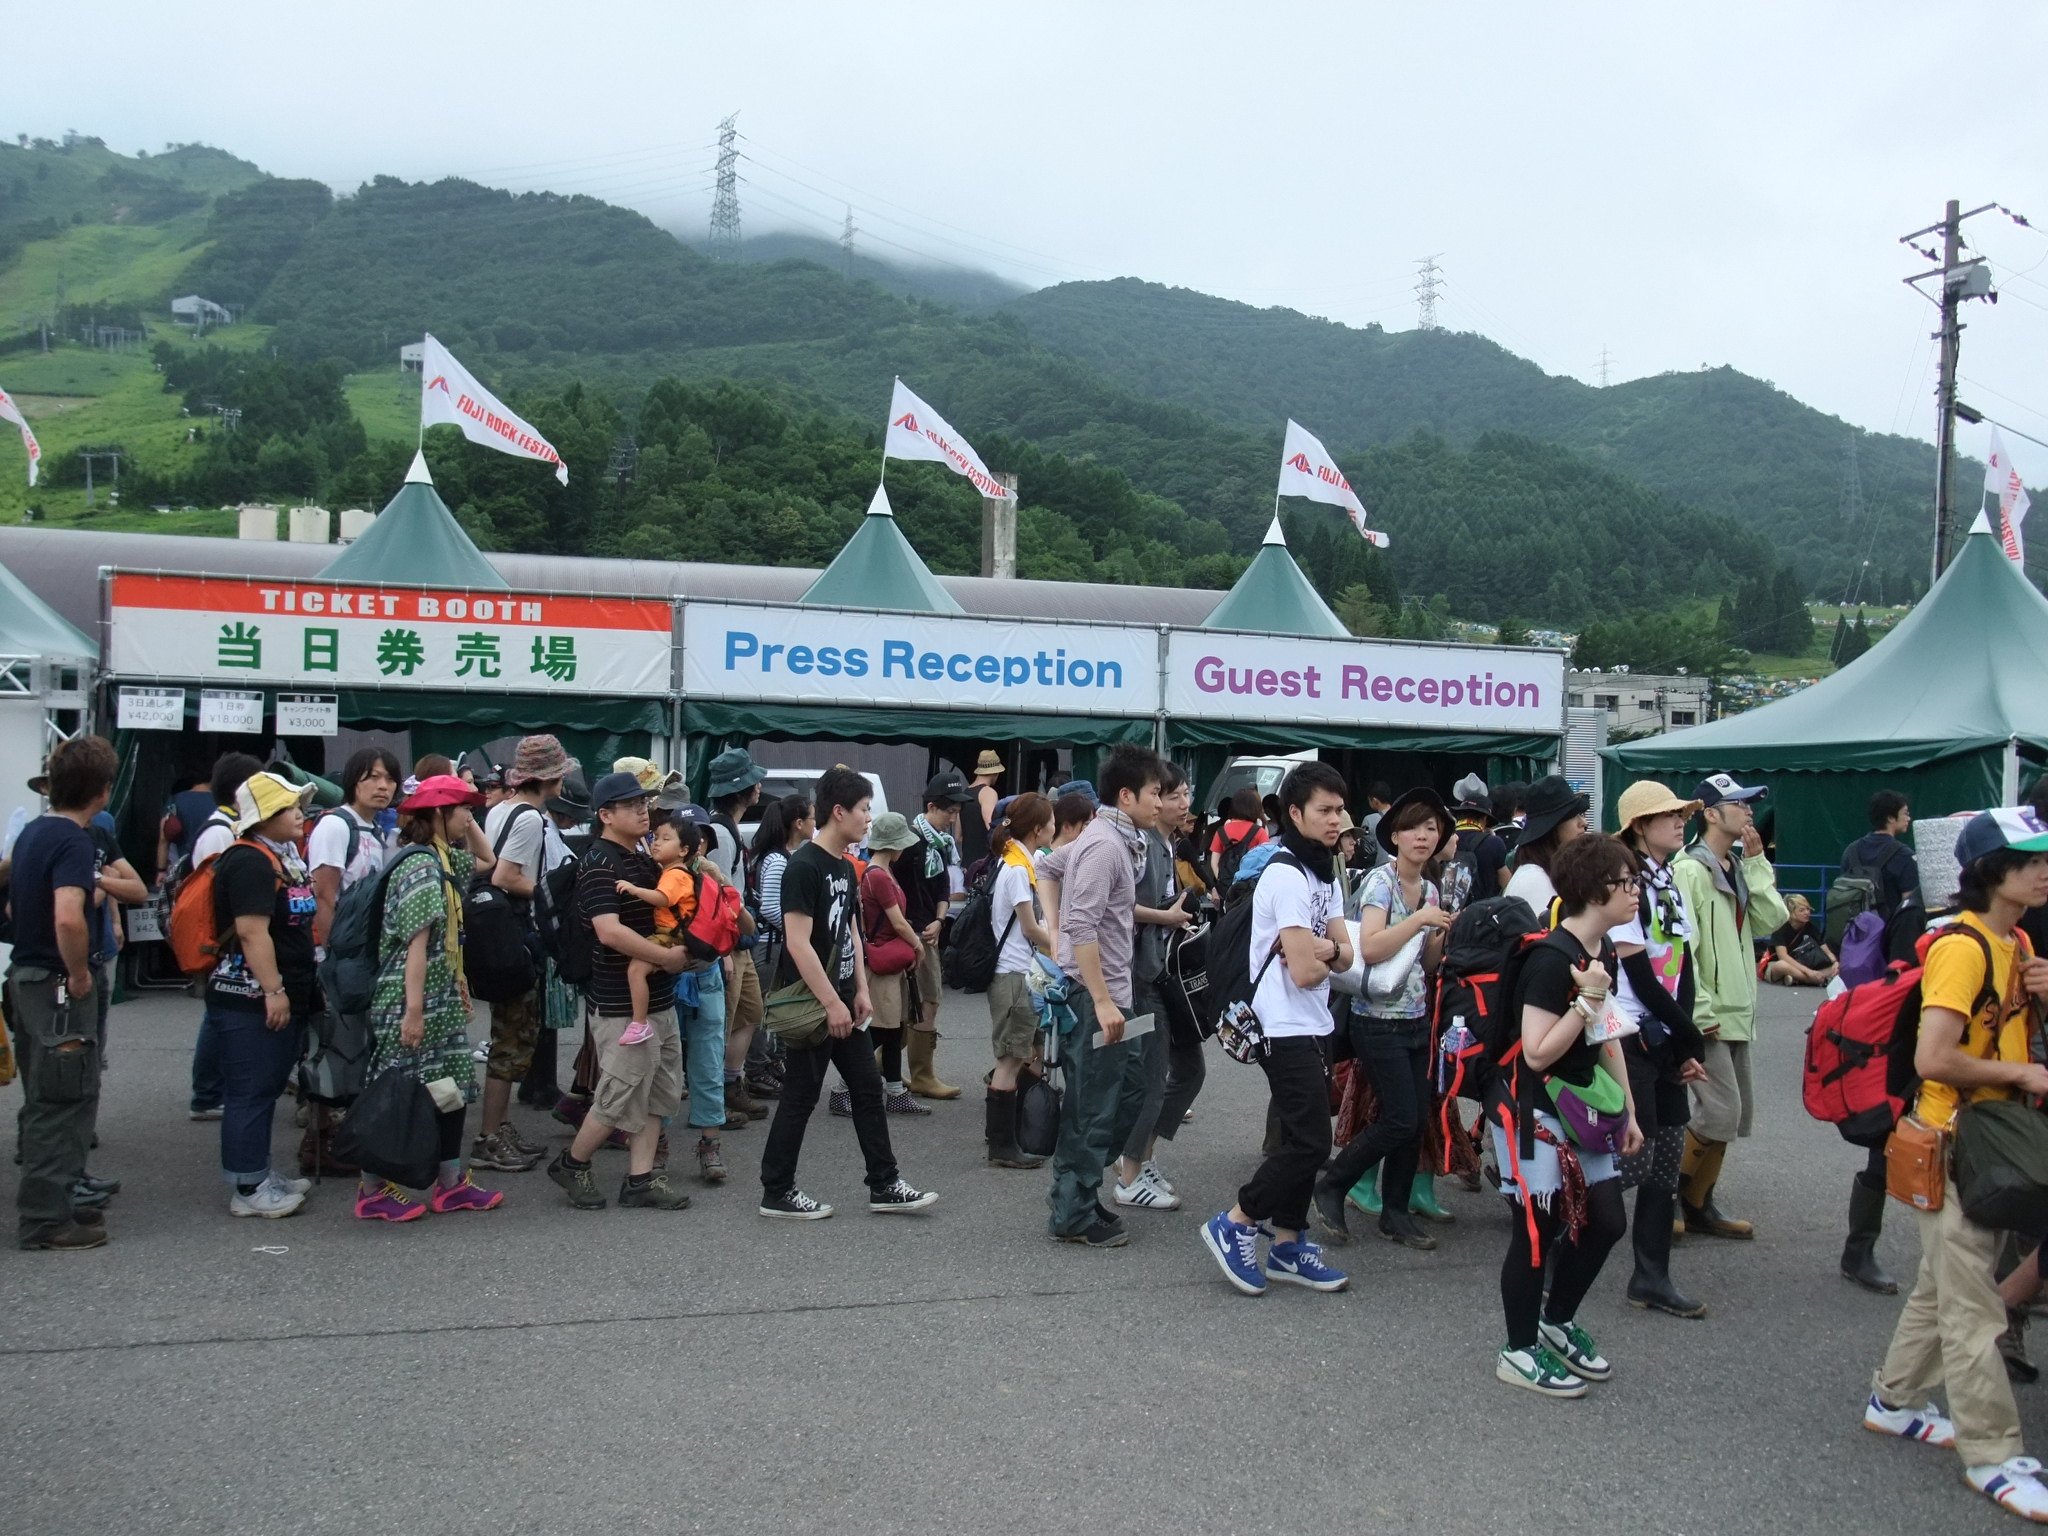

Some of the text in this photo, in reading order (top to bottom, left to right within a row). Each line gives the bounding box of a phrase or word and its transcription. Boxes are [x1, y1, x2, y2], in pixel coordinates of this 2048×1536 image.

[456, 394, 486, 422] FUJI
[485, 411, 518, 443] ROCK
[967, 466, 1008, 498] FESTIVAL
[1317, 465, 1342, 486] FUJI
[259, 589, 542, 622] TICKET BOOTH
[216, 622, 577, 683] 当日券売場
[724, 630, 1125, 689] Press Reception
[1194, 656, 1540, 708] Guest Reception
[128, 711, 175, 722] ¥42,000
[210, 714, 254, 725] ¥18,000
[288, 717, 326, 728] ¥3,000
[1189, 974, 1209, 990] TRANS
